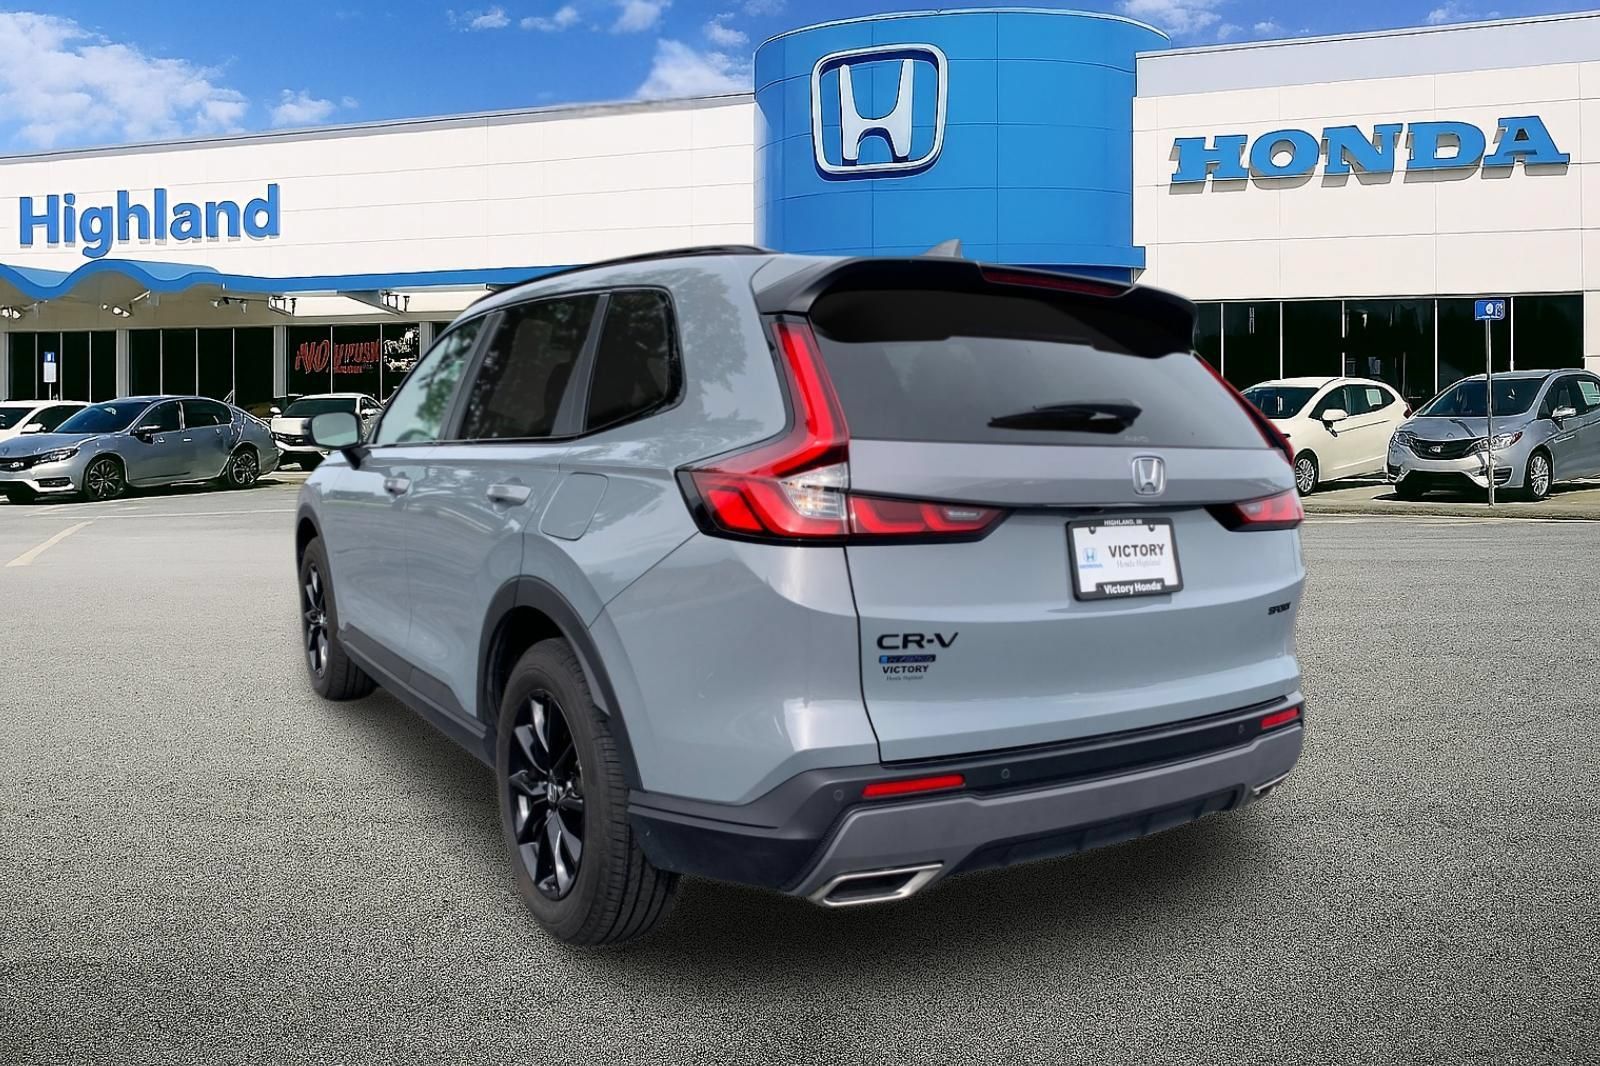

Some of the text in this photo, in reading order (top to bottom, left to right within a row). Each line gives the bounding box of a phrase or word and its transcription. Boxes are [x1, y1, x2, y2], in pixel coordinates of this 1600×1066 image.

[1171, 115, 1570, 182] HONDA
[19, 184, 280, 257] Highland
[1108, 543, 1165, 558] VICTORY
[1104, 581, 1162, 595] Victory Honda
[877, 632, 959, 650] CR-V
[882, 665, 929, 674] VICTORY
